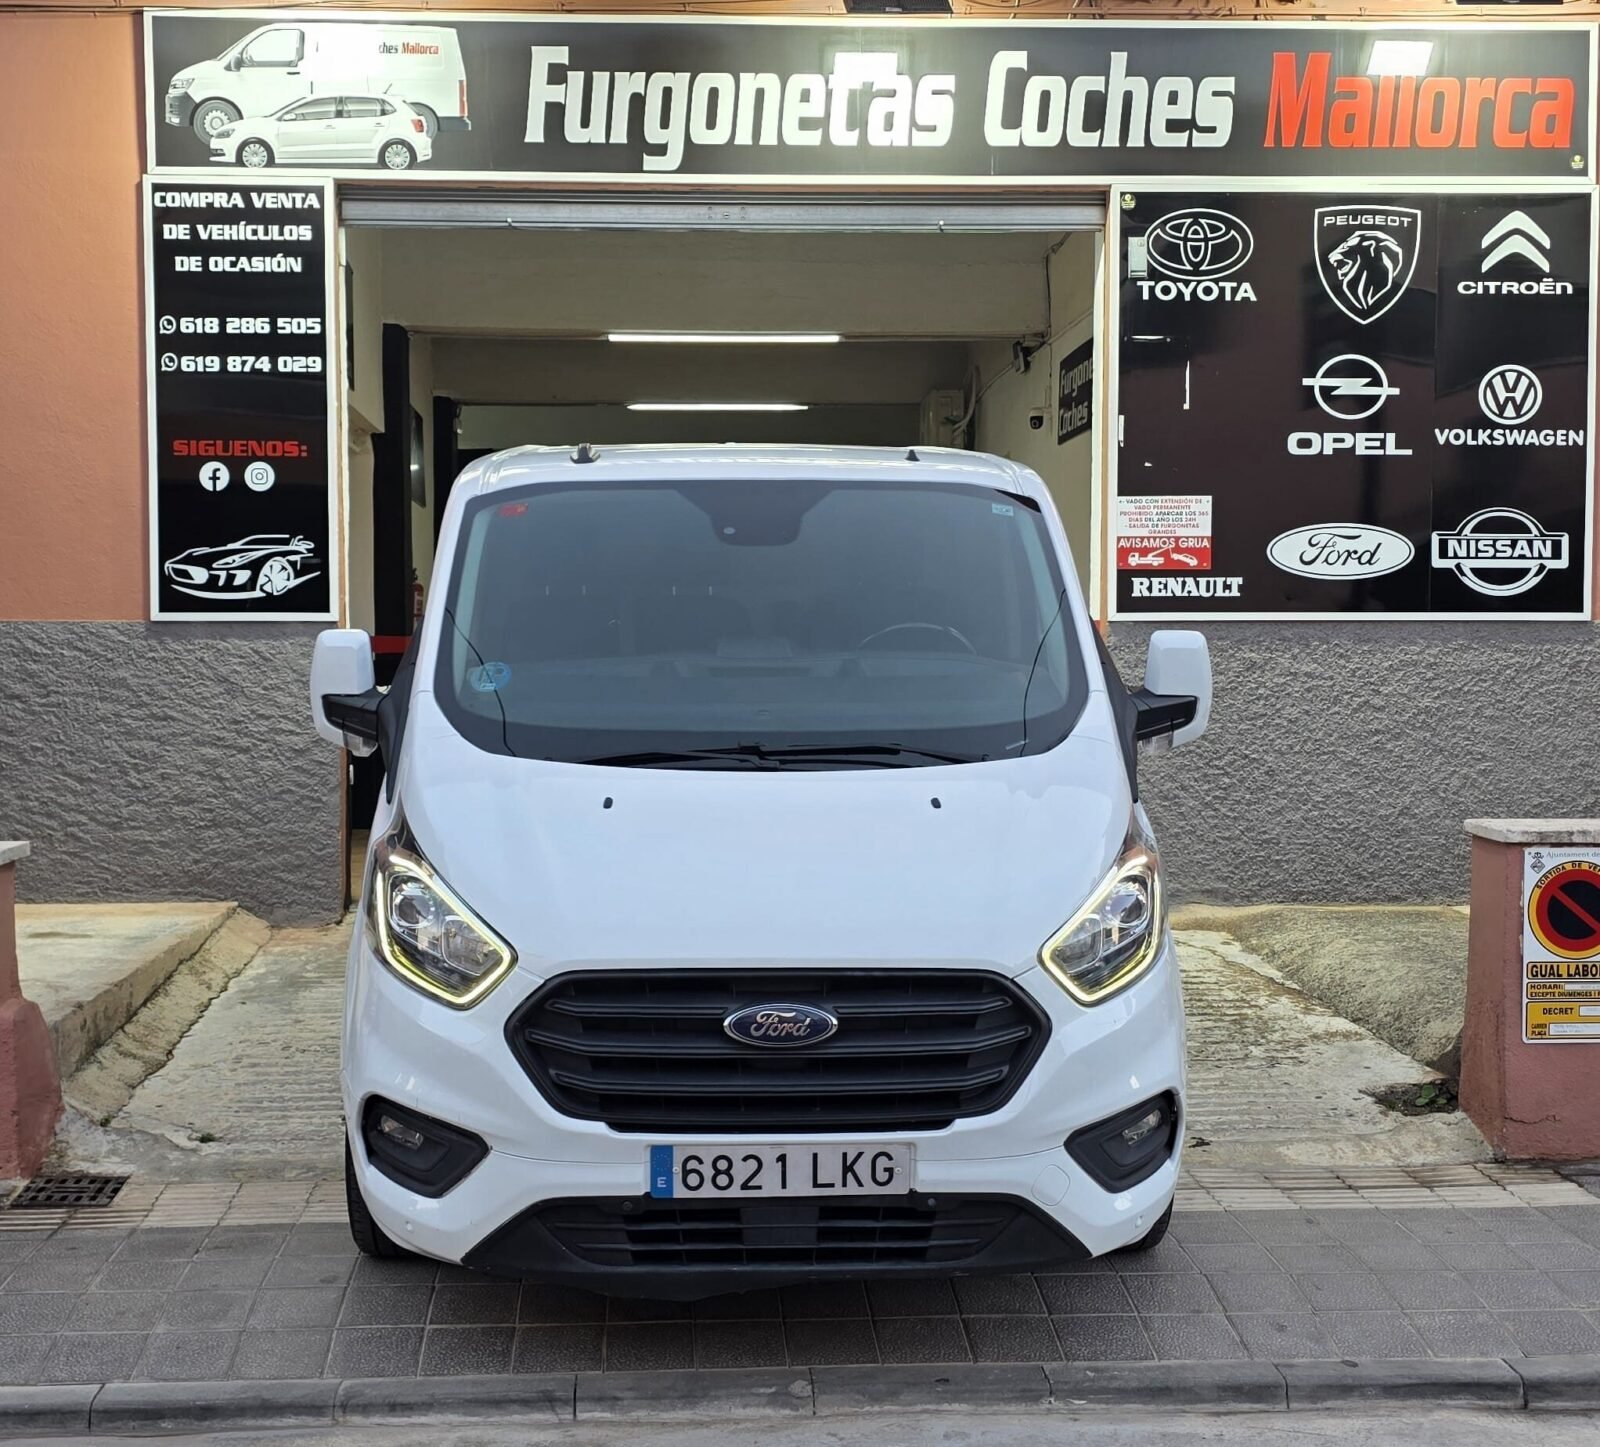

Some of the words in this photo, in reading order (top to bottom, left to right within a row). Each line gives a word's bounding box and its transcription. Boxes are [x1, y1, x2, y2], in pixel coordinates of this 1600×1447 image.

[378, 42, 398, 54] ches
[401, 42, 439, 54] Mallorca
[523, 45, 956, 171] Furgonetas
[984, 51, 1235, 148] Coches
[1264, 52, 1575, 148] Mallorca
[153, 192, 245, 208] COMPRA
[250, 192, 321, 209] VENTA
[1323, 214, 1412, 228] PEUGEOT
[163, 224, 191, 240] DE
[196, 221, 313, 241] VEHÍCULOS
[174, 256, 203, 272] DE
[208, 253, 303, 273] OCASIÓN
[1136, 280, 1257, 302] TOYOTA
[179, 317, 220, 334] 618
[225, 317, 271, 334] 286
[276, 317, 322, 335] 505
[180, 355, 221, 373] 619
[226, 355, 272, 373] 874
[277, 356, 323, 373] 029
[1059, 401, 1089, 437] Coches
[1287, 431, 1413, 455] OPEL
[1434, 428, 1585, 446] VOLKSWAGEN
[173, 440, 308, 457] SIGUENOS:
[1118, 537, 1176, 548] AVISAMOS
[1178, 538, 1210, 548] GRUA
[1298, 532, 1384, 566] Ford
[1447, 539, 1552, 558] NISSAN
[1130, 577, 1244, 597] RENAULT
[1536, 866, 1567, 890] SORTIDA
[1530, 964, 1563, 978] GUAL
[1567, 963, 1600, 978] LABO
[1542, 1007, 1575, 1015] DECRET
[750, 1010, 811, 1037] Ford
[657, 1176, 668, 1187] E
[681, 1152, 788, 1192] 6821
[811, 1151, 895, 1188] LKG
